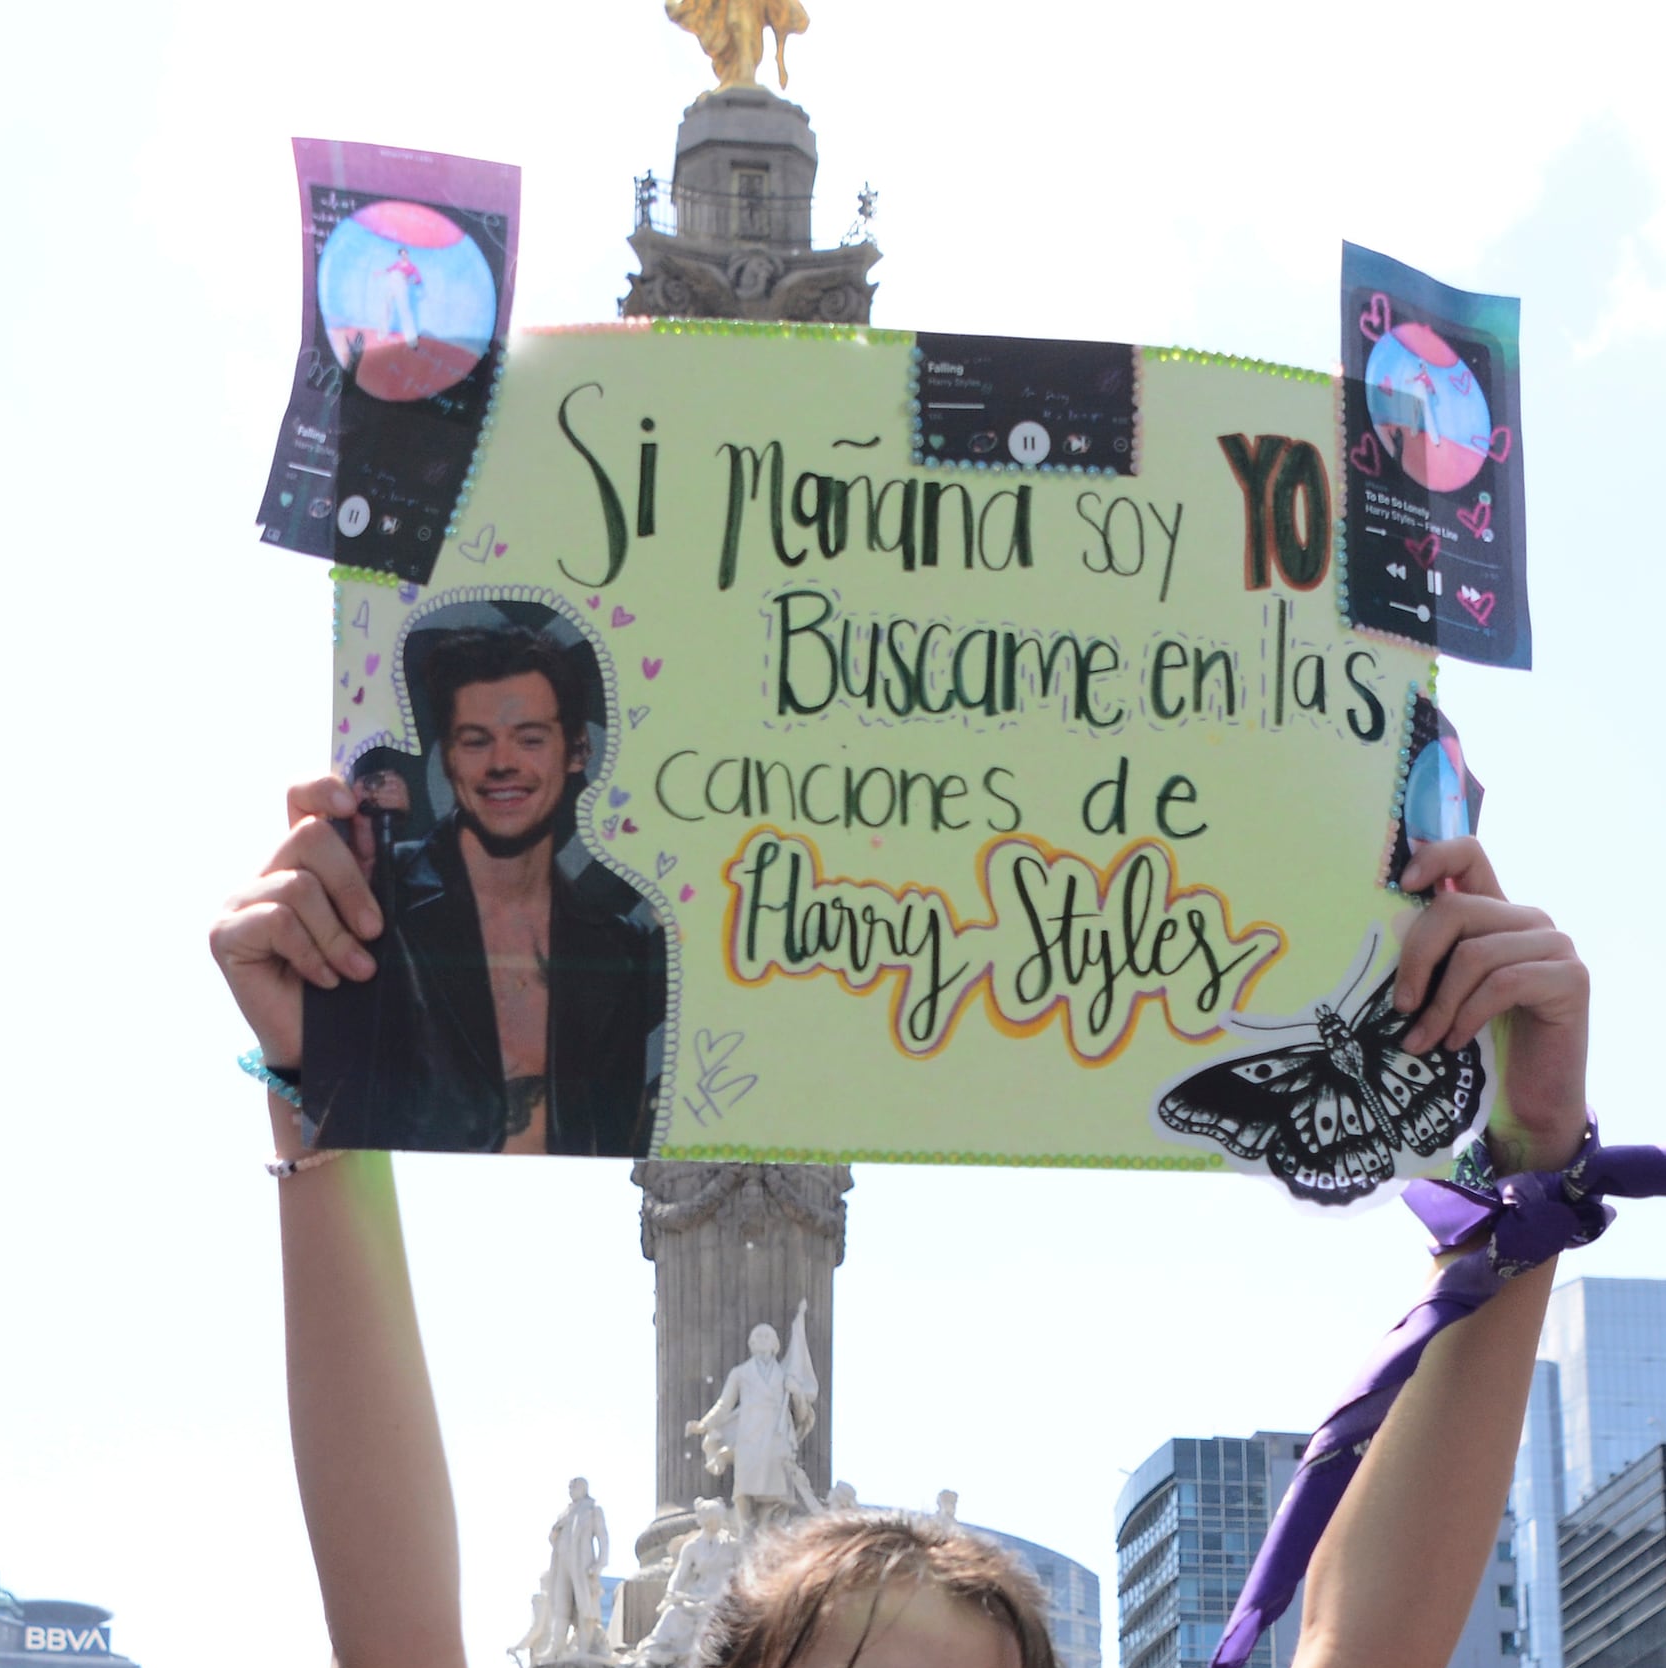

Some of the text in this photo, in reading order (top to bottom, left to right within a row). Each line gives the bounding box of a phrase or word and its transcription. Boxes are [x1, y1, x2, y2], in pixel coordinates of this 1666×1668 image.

[557, 381, 658, 592] Si
[1217, 432, 1332, 592] YO
[773, 588, 1386, 743] Buscame en las
[655, 750, 1207, 839] canciones de
[744, 841, 1259, 1041] Harry Styles
[25, 1626, 107, 1652] BBVA
